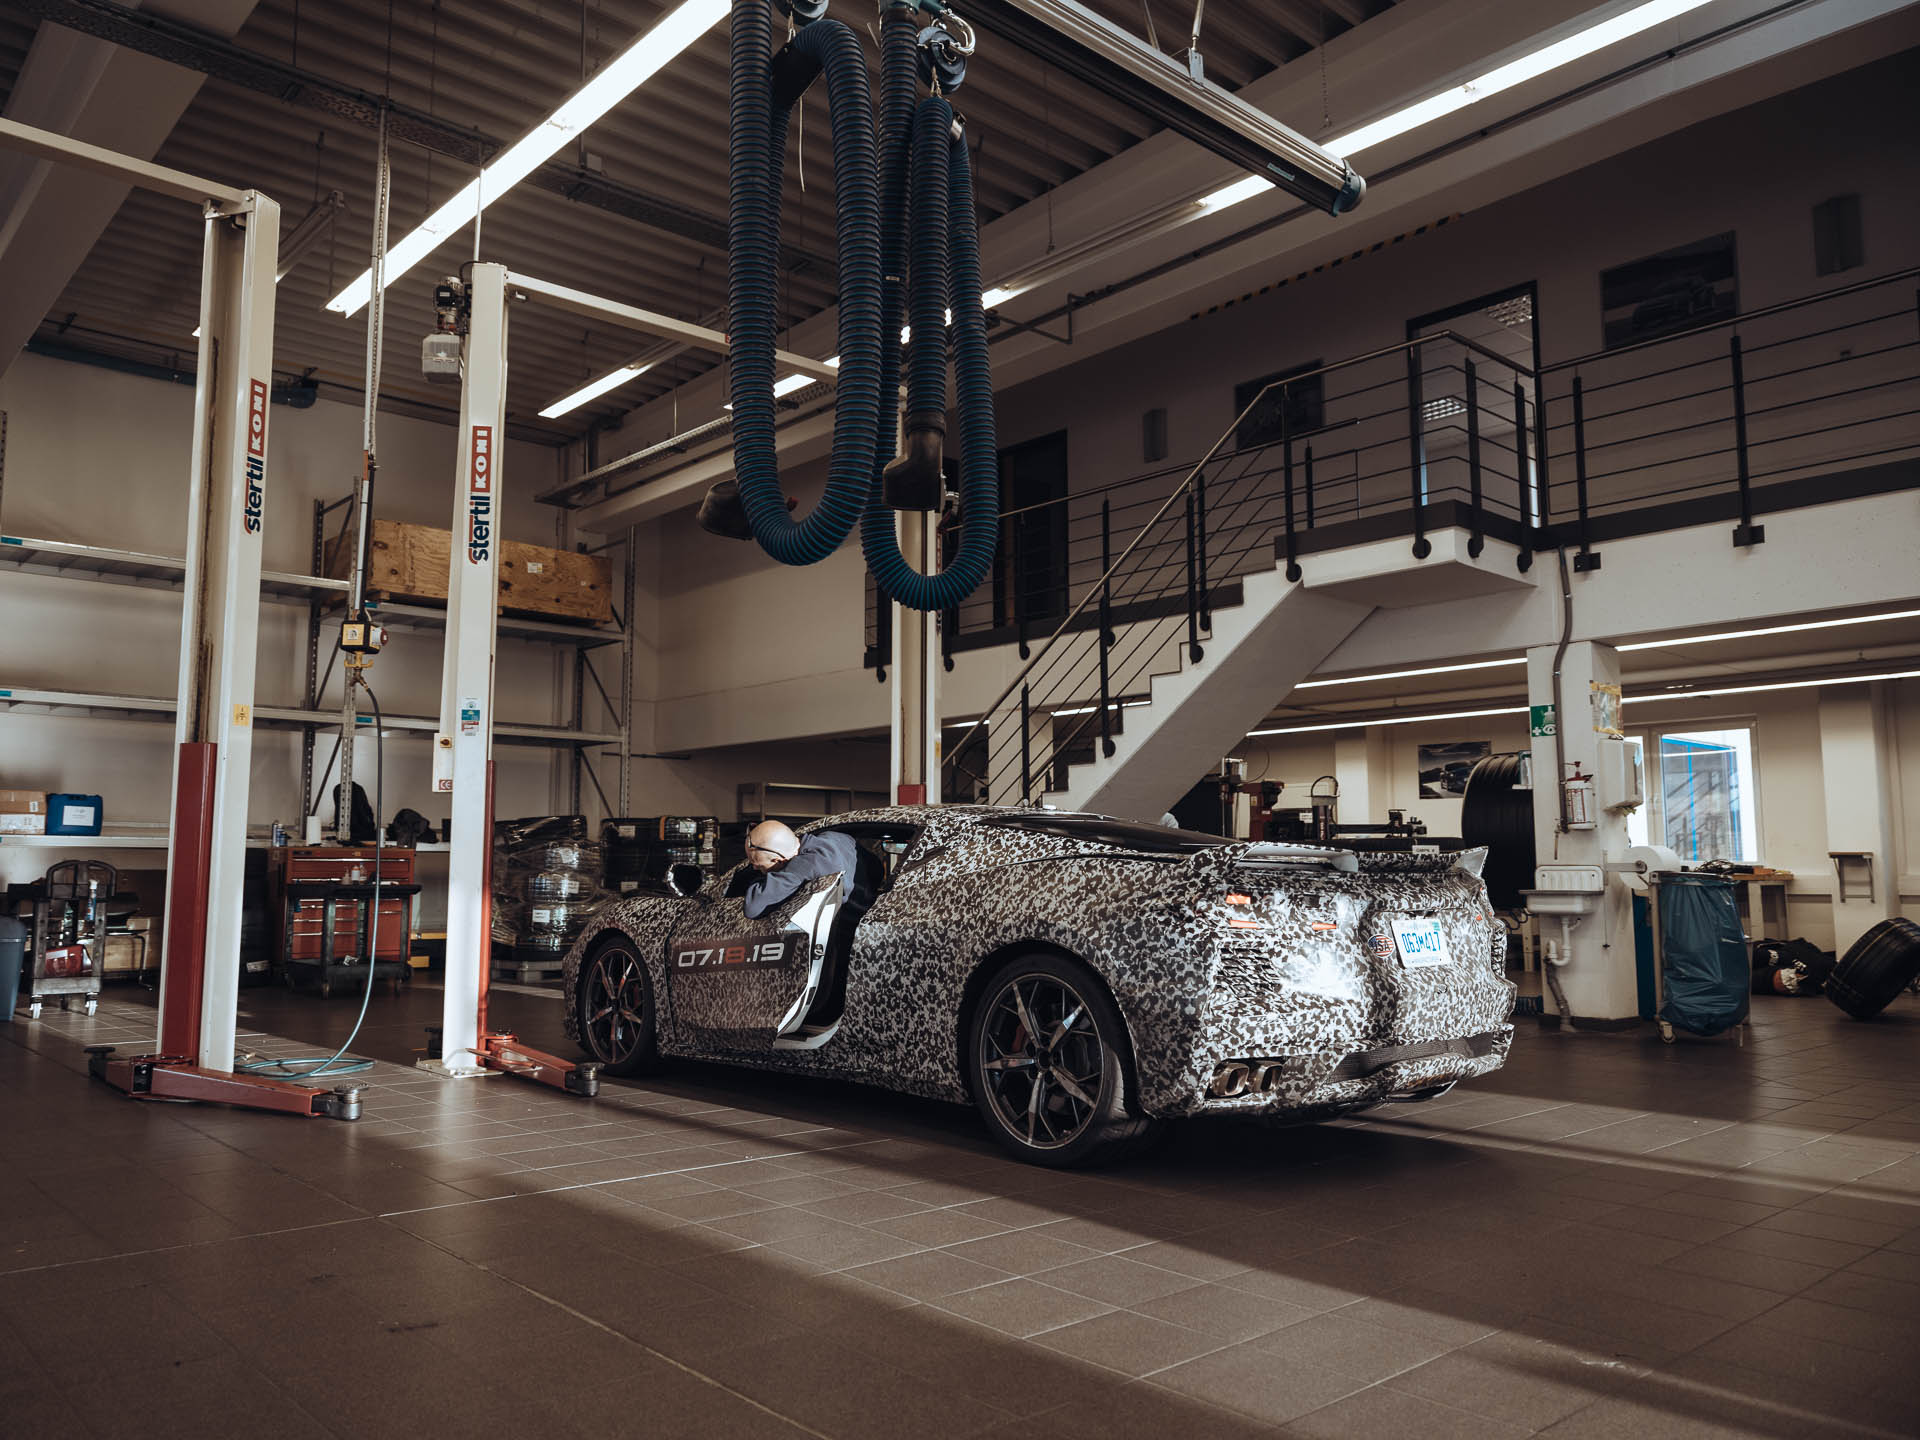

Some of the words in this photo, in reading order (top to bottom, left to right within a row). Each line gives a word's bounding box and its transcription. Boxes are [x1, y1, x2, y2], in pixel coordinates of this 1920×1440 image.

[251, 384, 264, 453] KONI
[474, 429, 489, 489] KONI
[244, 456, 264, 534] stertil
[468, 495, 490, 565] stertil
[678, 942, 785, 968] 07.18.19
